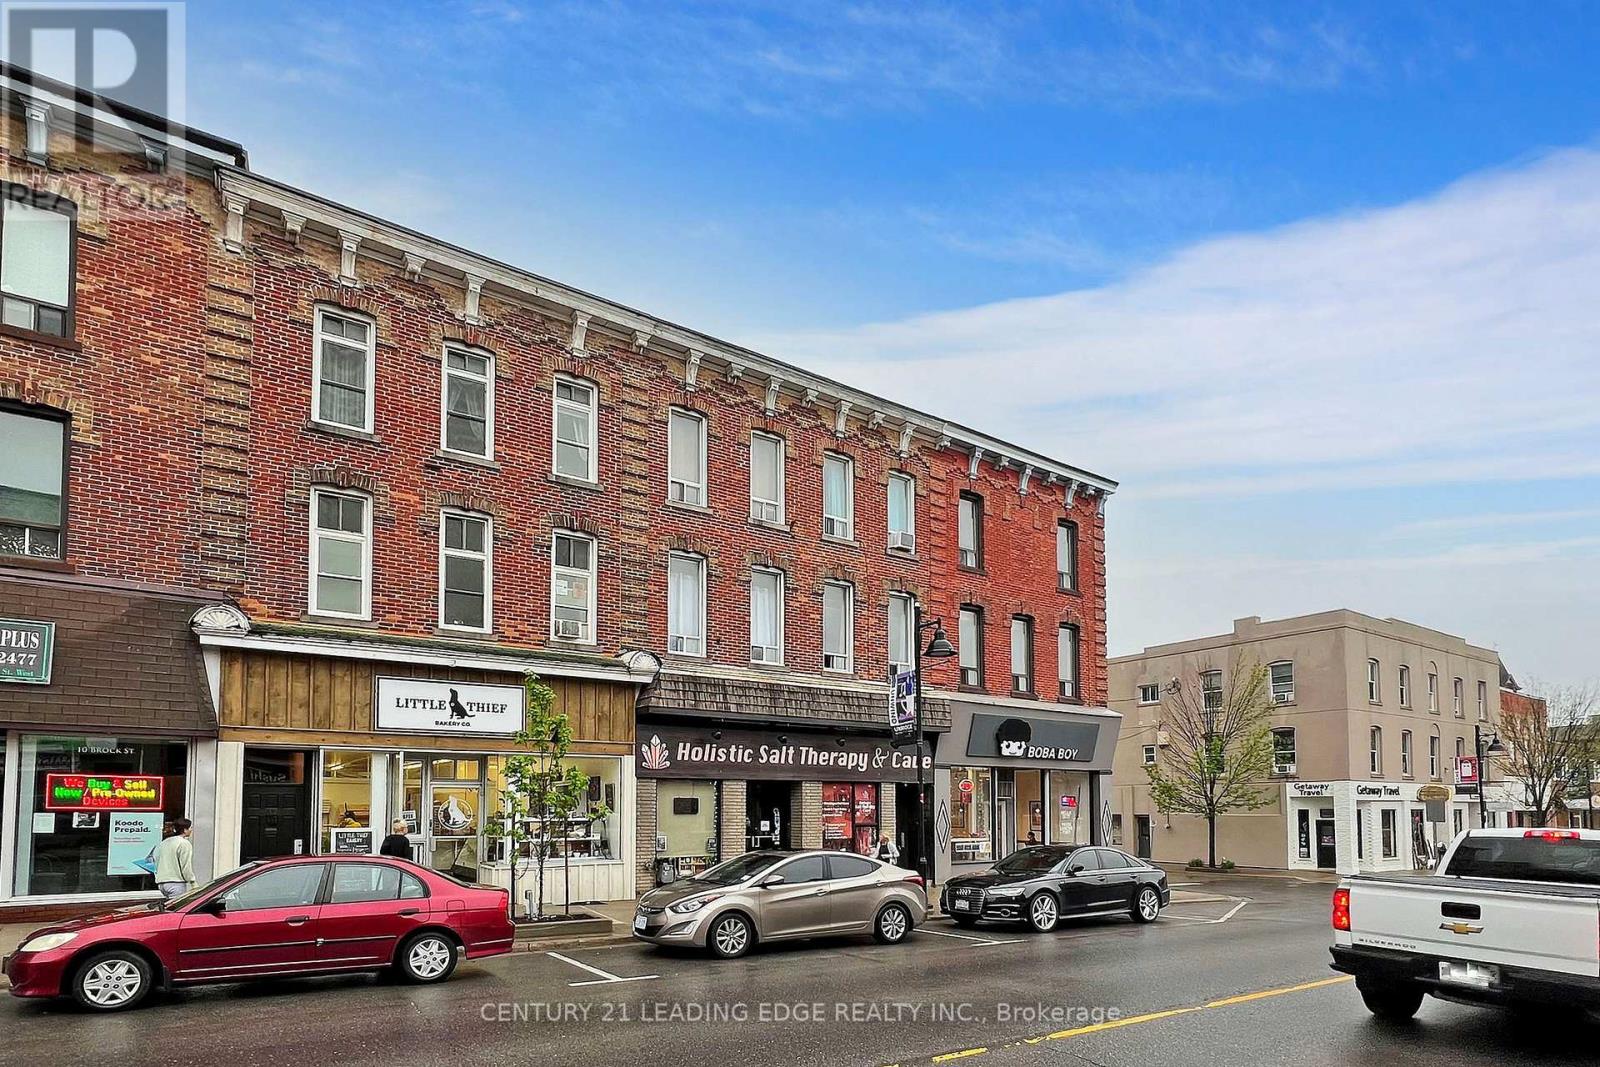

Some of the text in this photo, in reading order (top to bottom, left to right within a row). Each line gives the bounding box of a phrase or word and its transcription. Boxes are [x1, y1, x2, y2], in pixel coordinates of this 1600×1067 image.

[0, 629, 40, 649] PLUS
[395, 697, 508, 714] LITTLE THIEF
[90, 746, 121, 754] BROCK
[677, 742, 754, 763] Holistic
[758, 744, 795, 765] Salt
[799, 746, 869, 772] Therapy
[872, 747, 890, 769] &
[1027, 746, 1079, 760] BOBA BOY
[1293, 783, 1329, 791] Getaway
[1356, 784, 1400, 798] Getaway Travel
